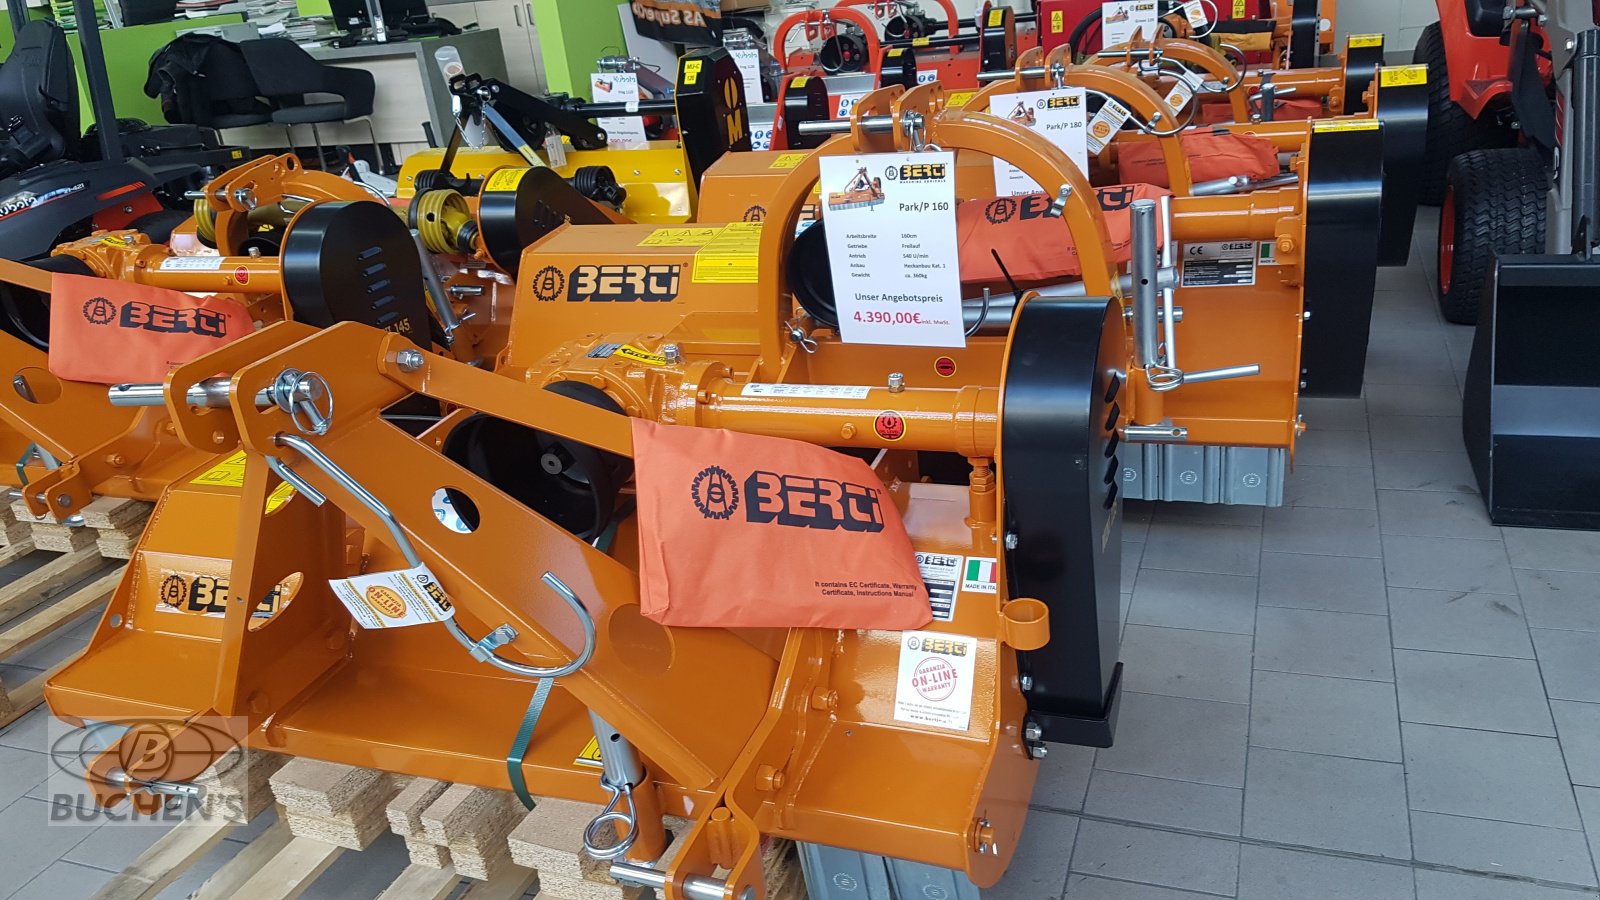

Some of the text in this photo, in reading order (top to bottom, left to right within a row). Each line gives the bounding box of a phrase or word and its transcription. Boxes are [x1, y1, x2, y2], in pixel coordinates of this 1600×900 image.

[1046, 123, 1068, 131] Park/P
[899, 202, 949, 213] Park/P 160
[855, 293, 943, 304] Unser Angebotspreis
[854, 311, 921, 325] 4.390,00€
[892, 583, 917, 591] Warranty
[822, 589, 855, 597] Certificate,
[918, 664, 946, 675] GARANZIA
[912, 668, 958, 687] ON-LINE
[922, 682, 951, 692] WARRANTY
